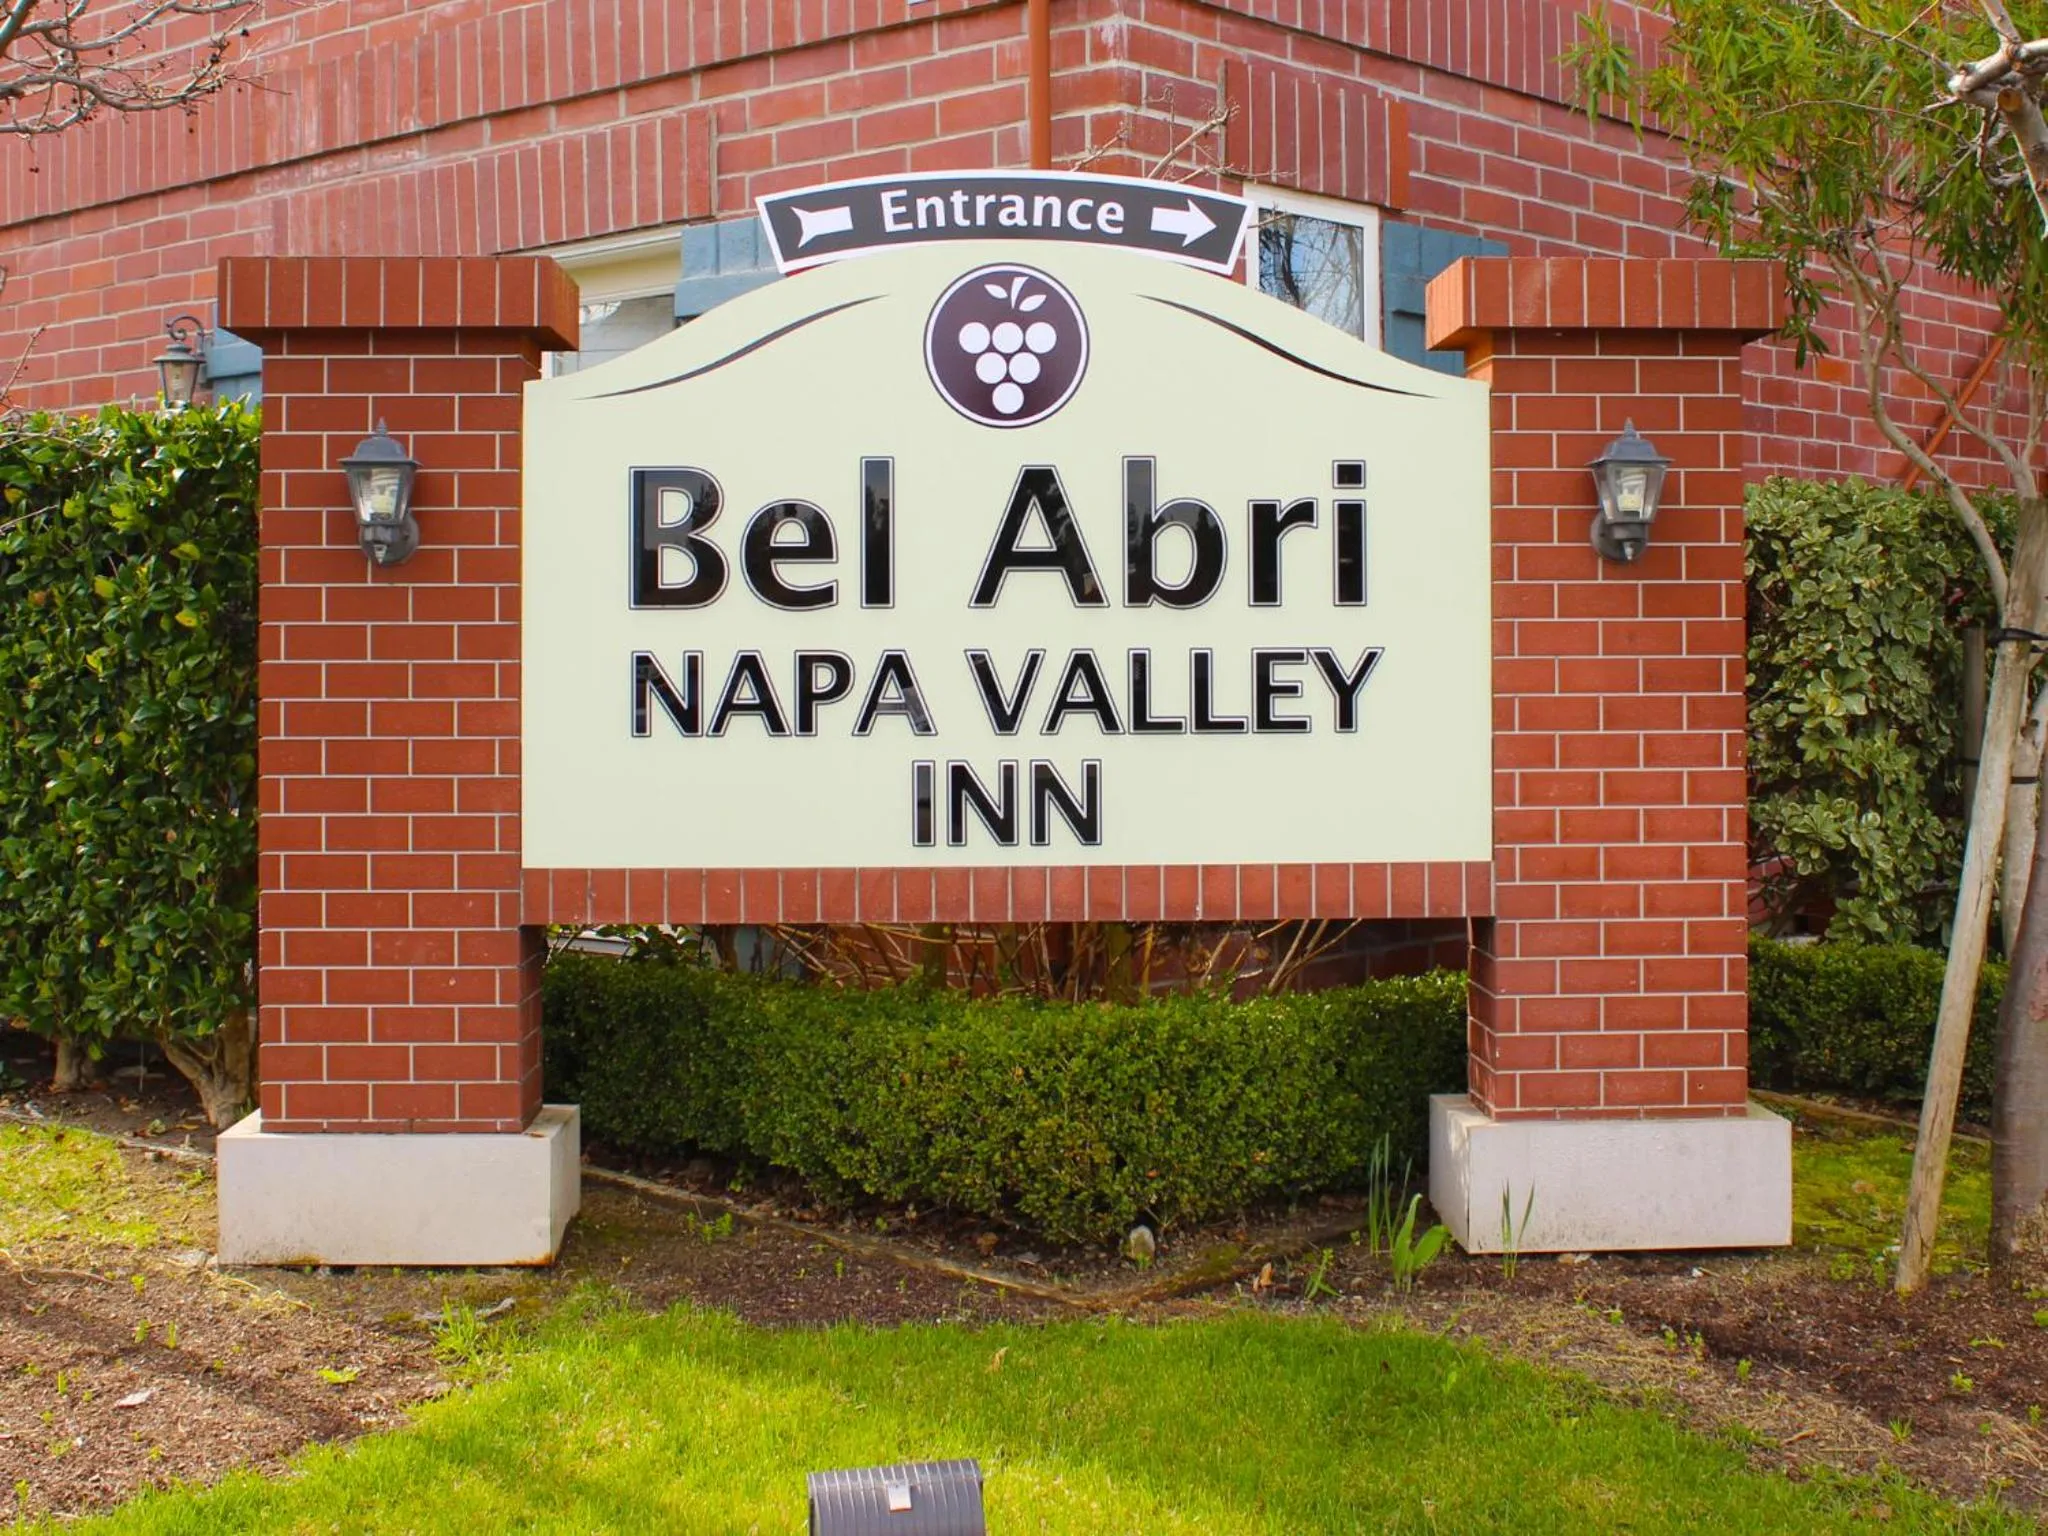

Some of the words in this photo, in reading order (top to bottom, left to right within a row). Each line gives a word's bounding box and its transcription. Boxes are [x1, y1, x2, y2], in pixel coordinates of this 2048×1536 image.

[880, 188, 1125, 236] Entrance
[629, 457, 894, 611] Bel
[968, 455, 1366, 610] Abri
[632, 650, 938, 737] NAPA
[965, 647, 1384, 736] VALLEY
[912, 759, 1102, 848] INN
